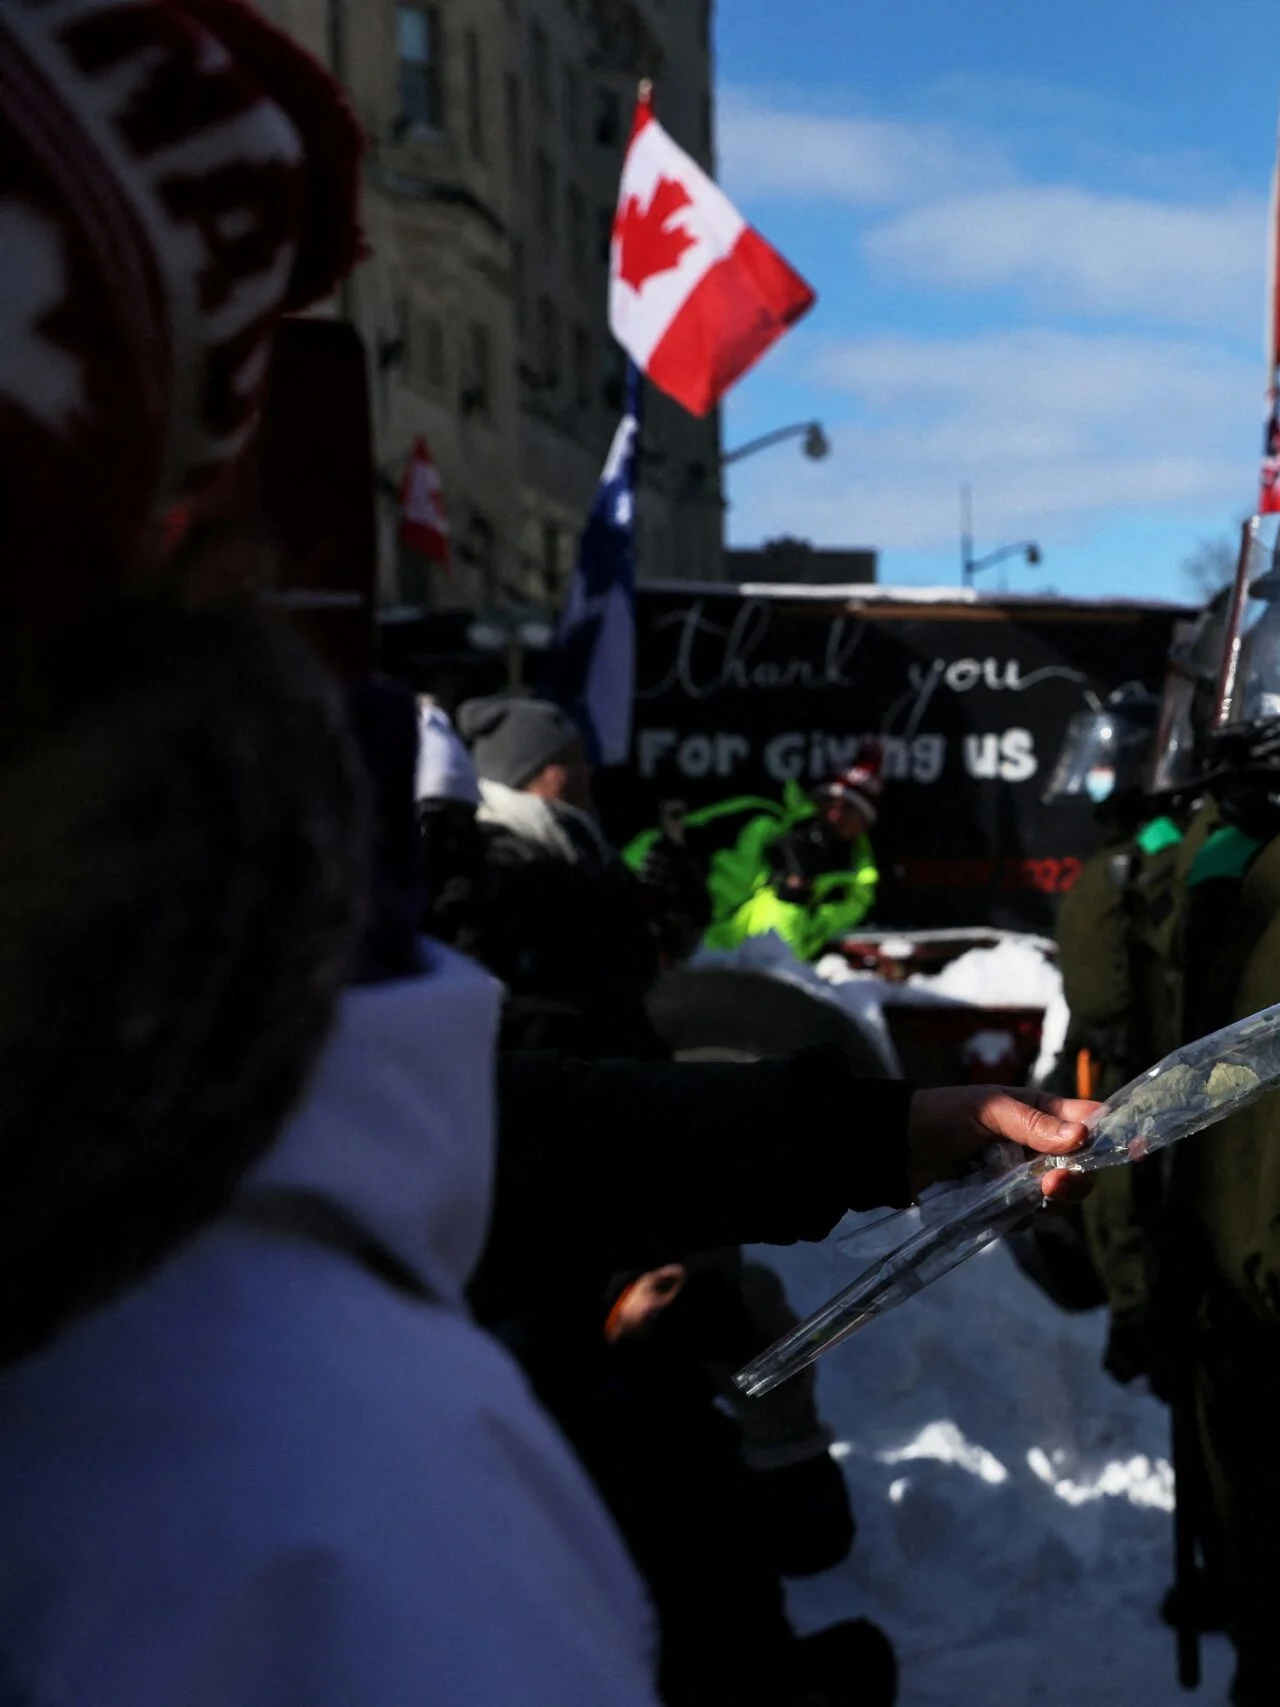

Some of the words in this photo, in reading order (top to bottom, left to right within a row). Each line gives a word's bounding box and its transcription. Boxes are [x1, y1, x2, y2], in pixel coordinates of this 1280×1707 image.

[638, 599, 868, 700] thank
[880, 656, 1087, 738] you
[636, 727, 750, 780] For
[763, 728, 948, 785] Givng
